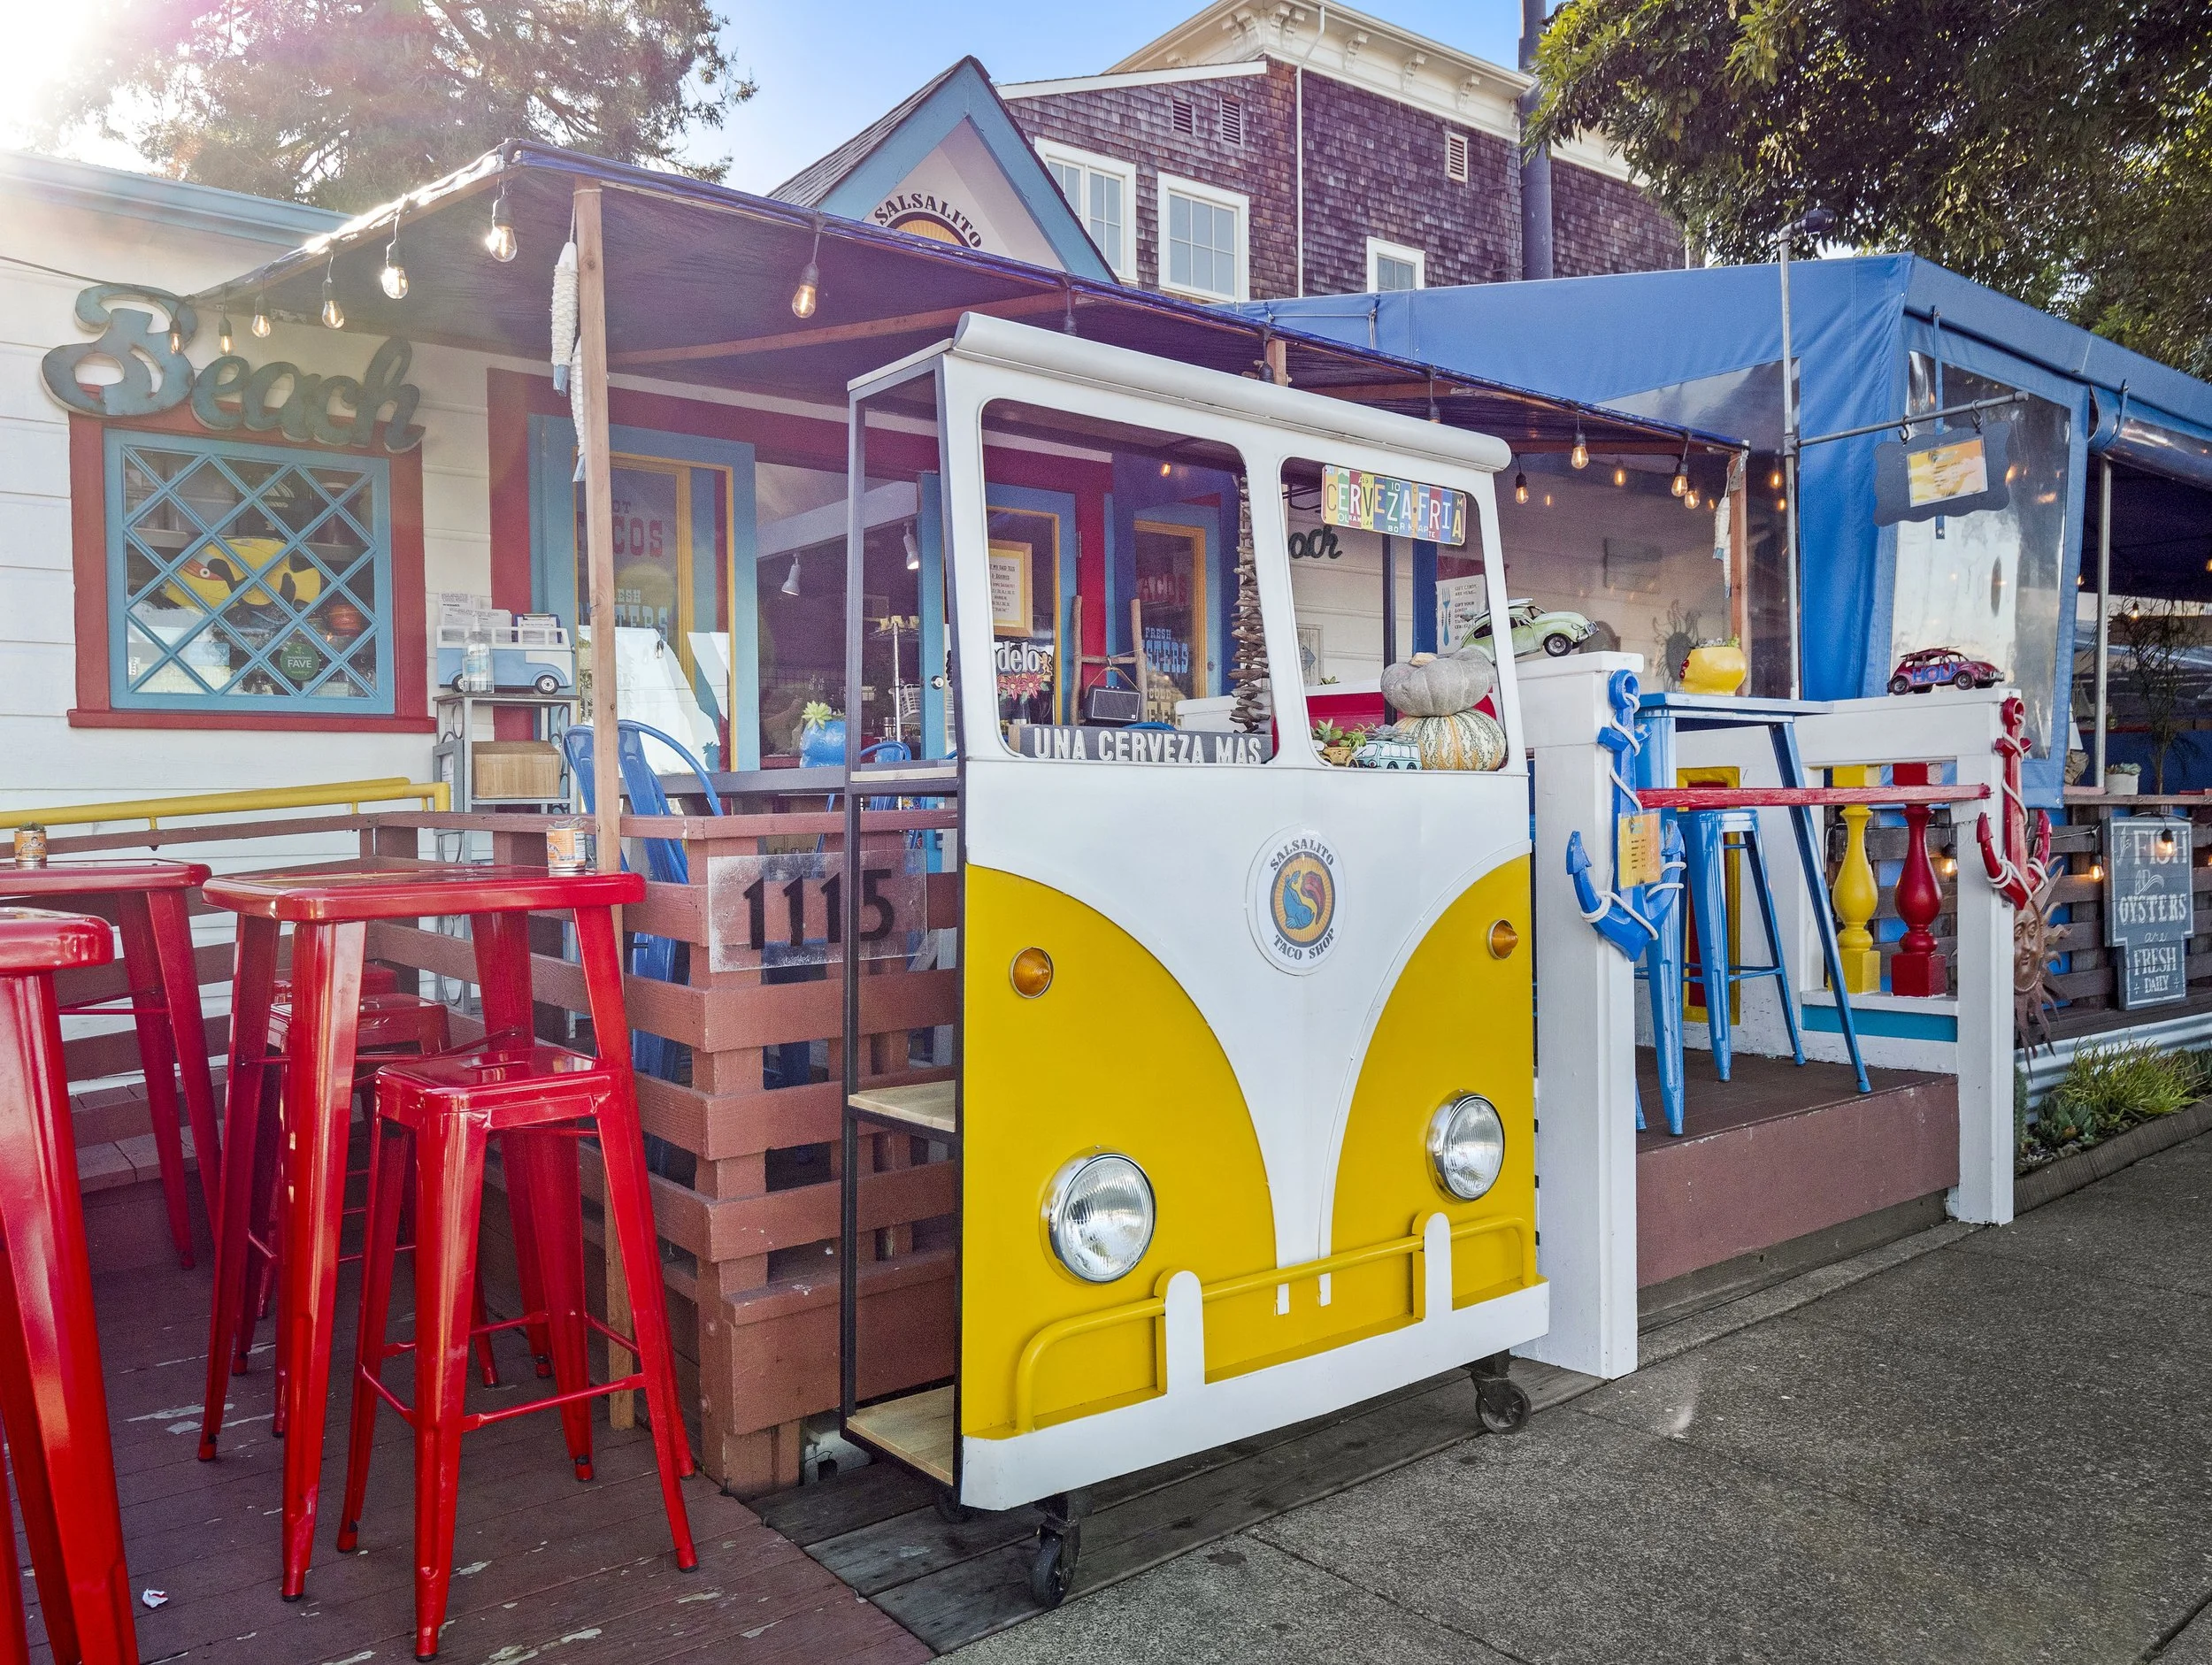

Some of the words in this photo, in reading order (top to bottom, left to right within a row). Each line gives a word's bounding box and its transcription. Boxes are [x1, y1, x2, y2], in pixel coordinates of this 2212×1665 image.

[874, 193, 982, 248] SALSALITO
[41, 283, 426, 455] Beach
[1326, 482, 1412, 522] CERVEZA
[1417, 491, 1462, 538] FRIA
[1288, 525, 1343, 559] ach
[1145, 626, 1171, 640] FRESH
[288, 659, 312, 668] FAVE
[996, 641, 1041, 672] delo
[1141, 640, 1189, 674] STERS
[1033, 727, 1087, 759] UNA
[1098, 731, 1205, 763] CERVEZA
[1216, 735, 1263, 764] MAS
[1270, 838, 1334, 871] SALSALITO
[742, 868, 895, 950] 1115
[2119, 894, 2187, 925] OYSTERS
[1273, 933, 1303, 961] TACO
[1309, 927, 1334, 960] SHOP
[2144, 932, 2168, 943] are
[2133, 947, 2177, 977] FRESH
[2144, 975, 2170, 994] DAILY
